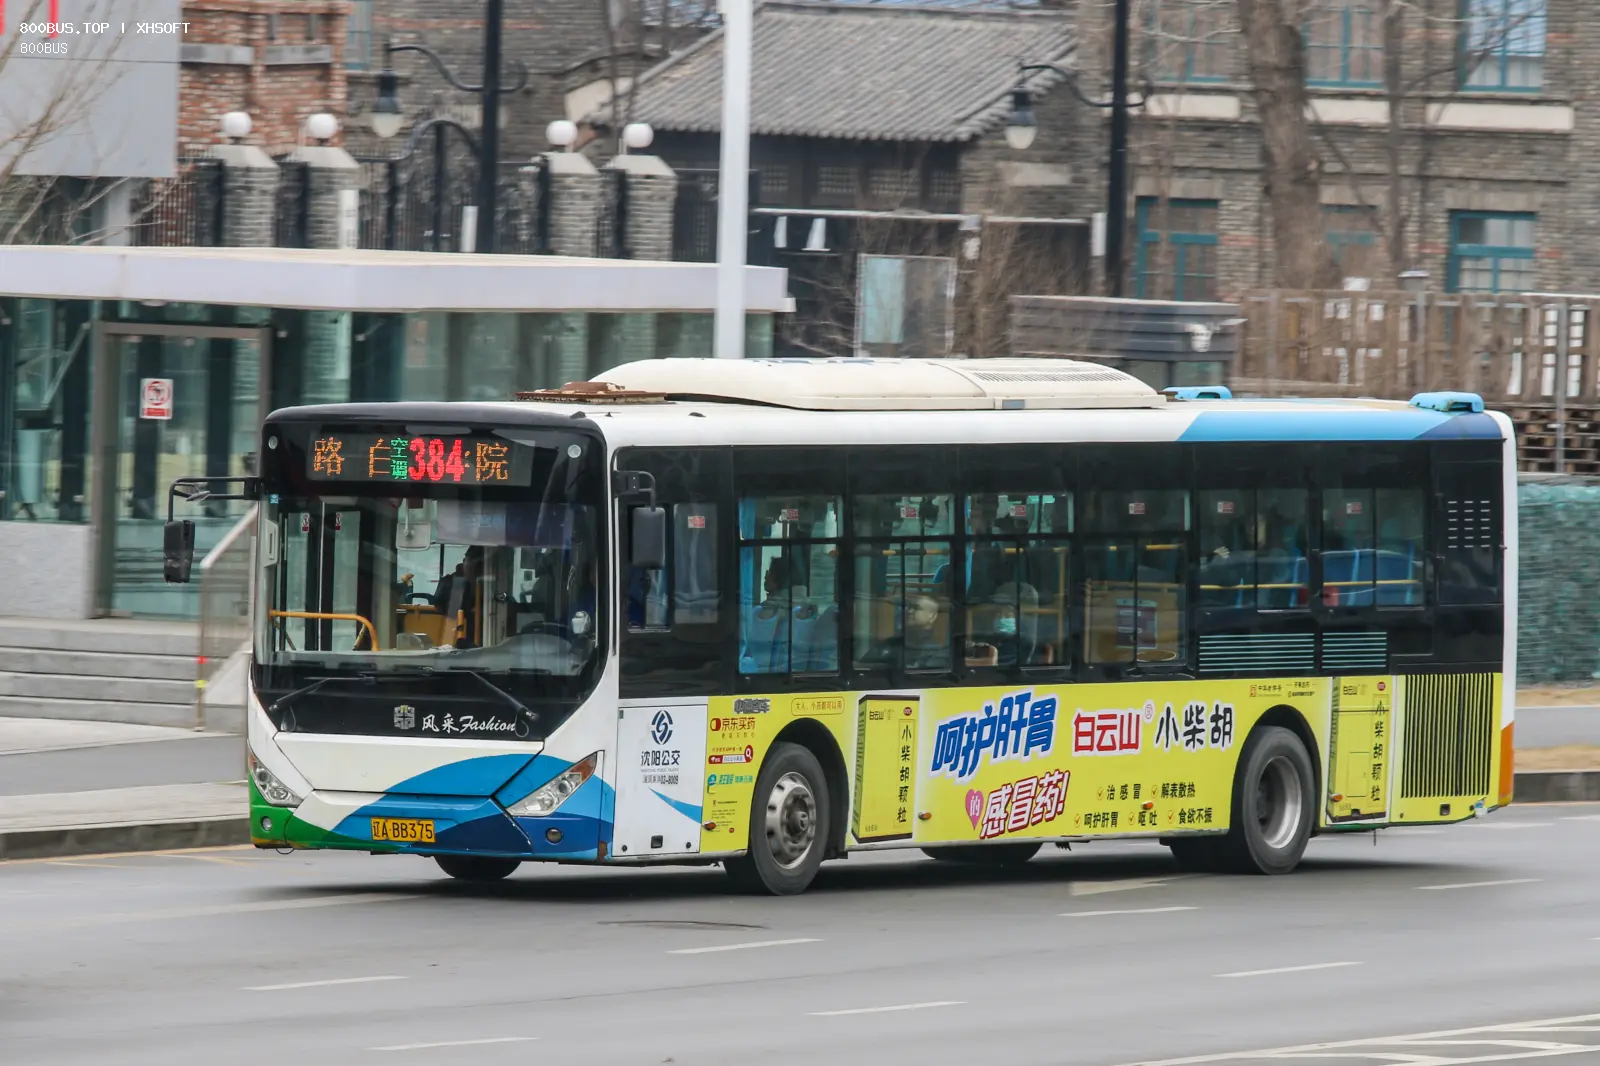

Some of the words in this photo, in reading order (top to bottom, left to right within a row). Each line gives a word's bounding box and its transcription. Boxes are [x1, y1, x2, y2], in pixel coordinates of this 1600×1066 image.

[314, 437, 344, 476] 路
[390, 437, 408, 480] 空调
[408, 437, 465, 481] 384
[465, 442, 509, 481] 院
[422, 713, 459, 733] 风采
[459, 715, 516, 733] Fashion
[721, 717, 756, 731] 京东买药
[931, 692, 1056, 778] 呵护肝胃
[1074, 712, 1140, 752] 白云山
[1155, 704, 1233, 749] 小柴胡
[640, 750, 681, 766] 沈阳公交
[897, 724, 912, 823] 小柴胡颗粒
[979, 769, 1070, 839] 感冒药!
[1106, 784, 1142, 801] 治感冒
[1161, 782, 1196, 798] 解表散热
[1084, 811, 1119, 829] 呵护肝胃
[1137, 809, 1158, 826] 呕吐
[1178, 807, 1213, 824] 食欲不振
